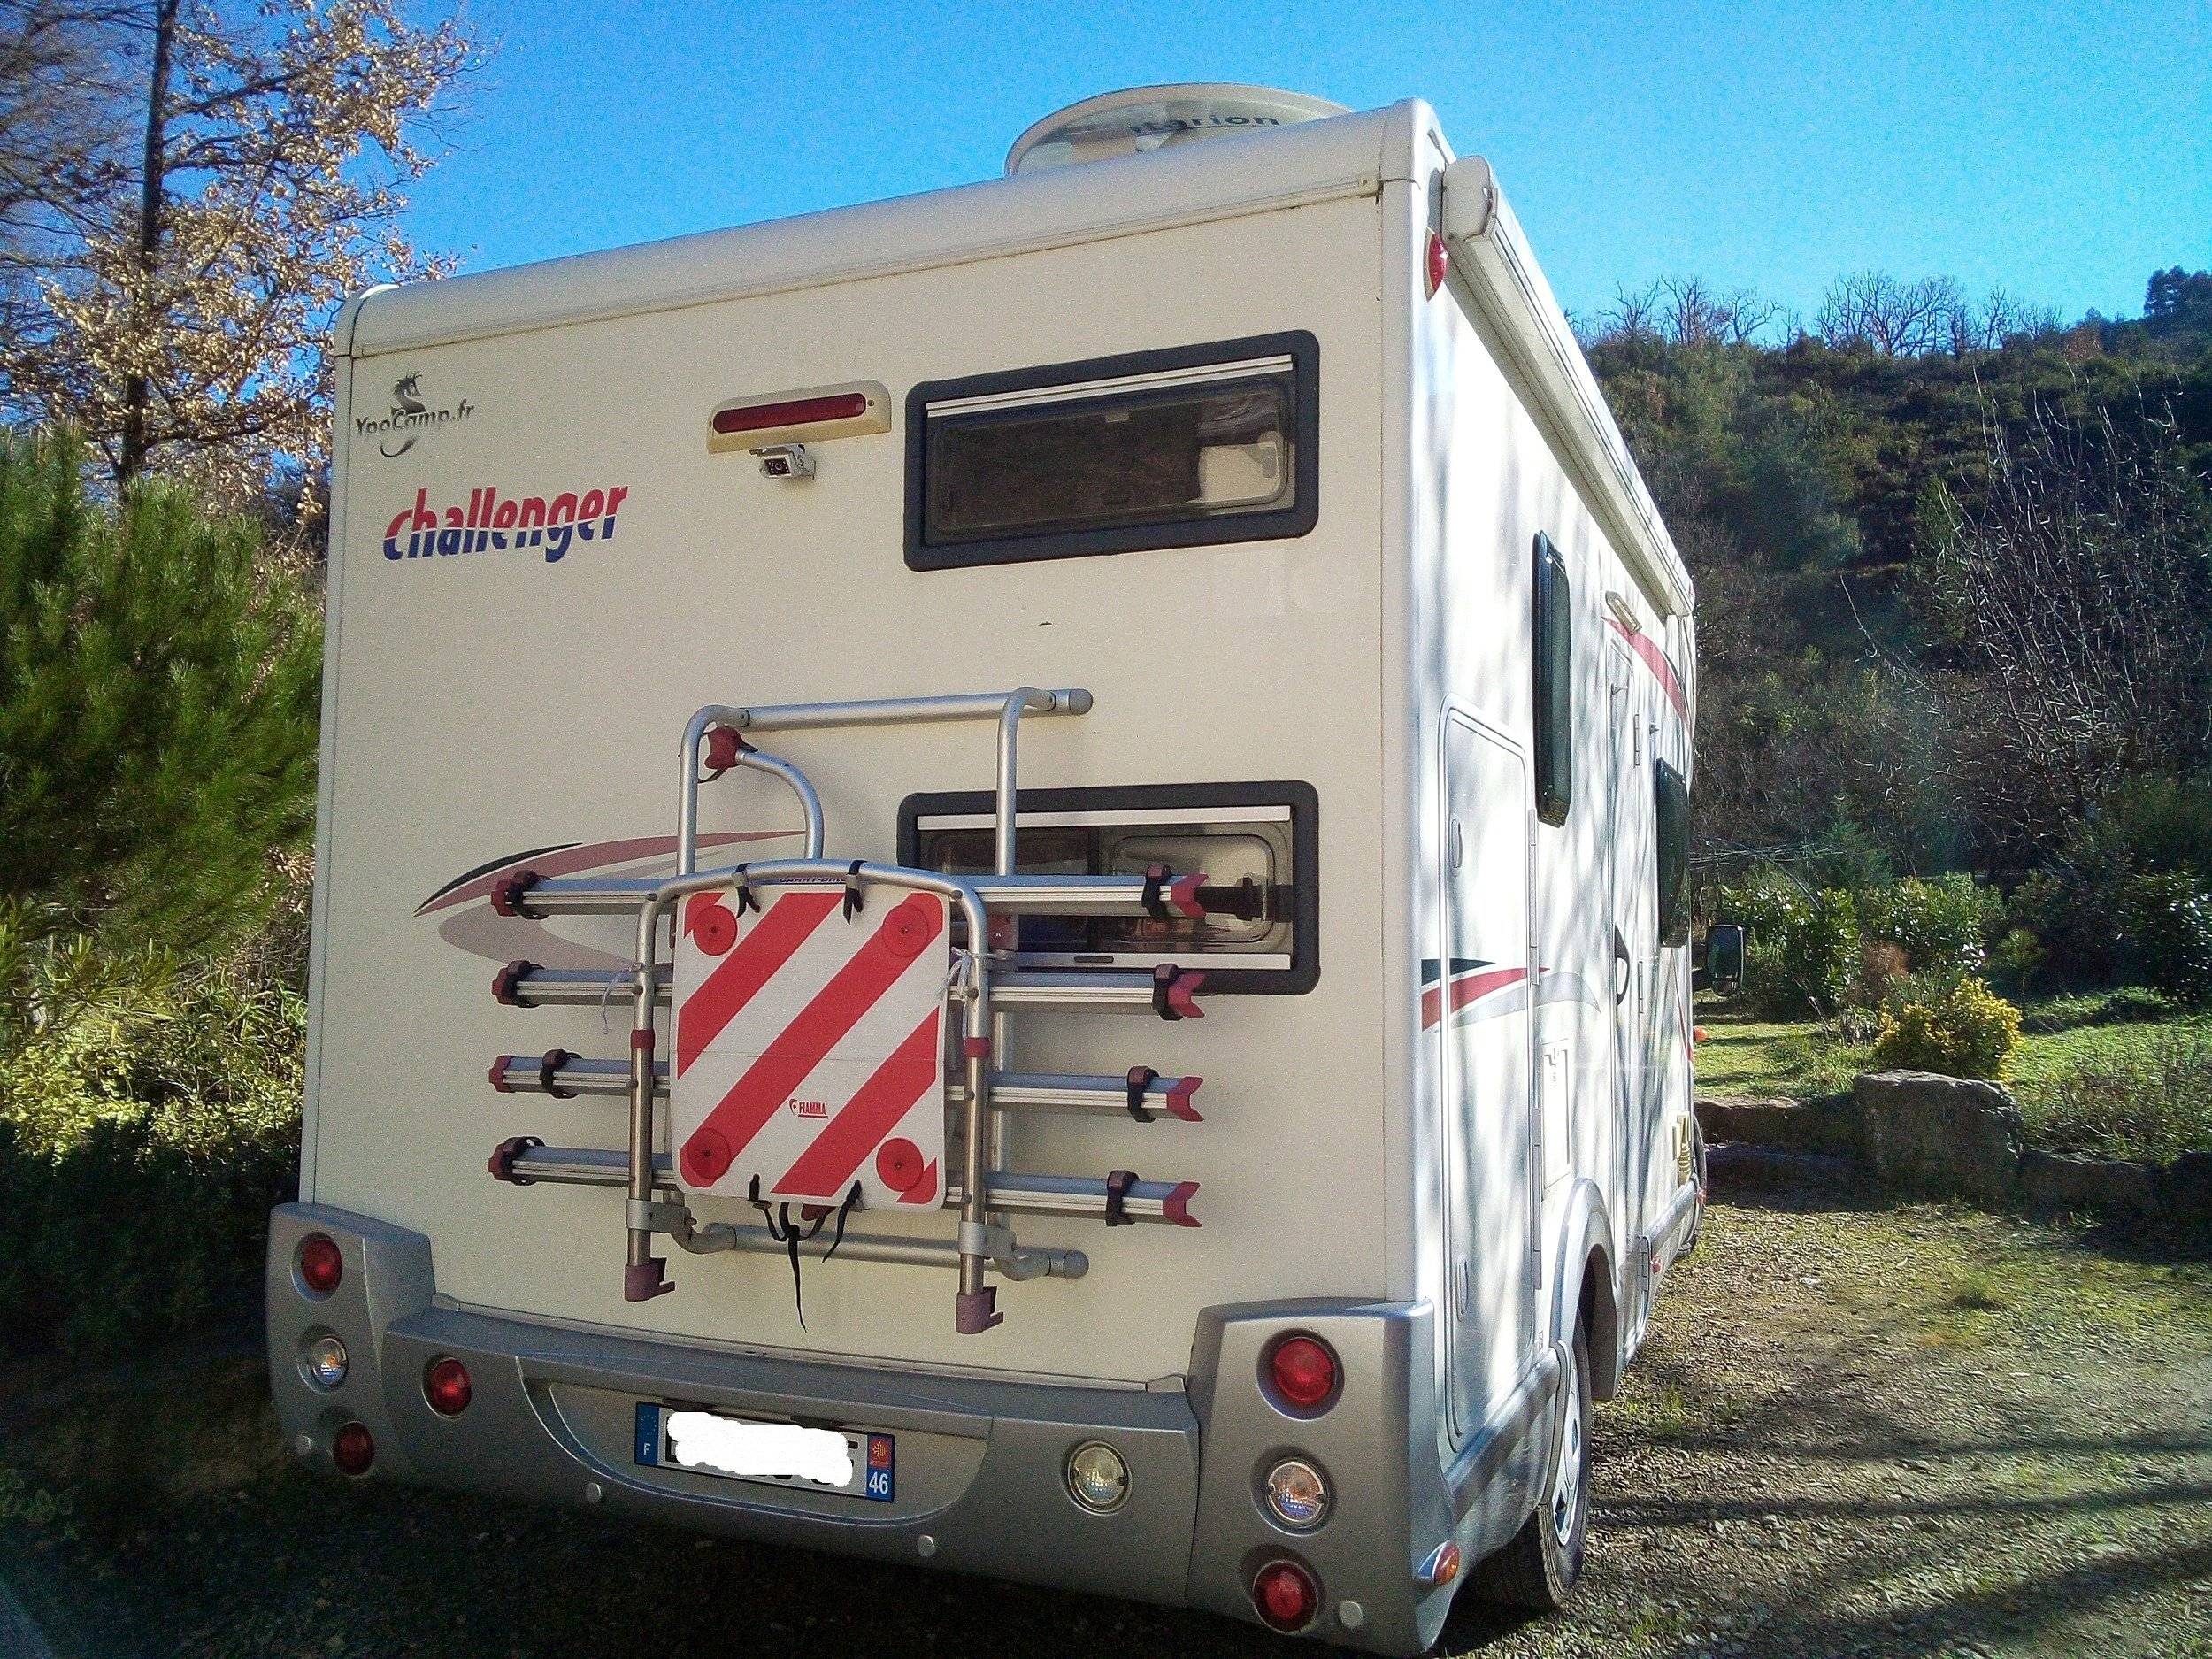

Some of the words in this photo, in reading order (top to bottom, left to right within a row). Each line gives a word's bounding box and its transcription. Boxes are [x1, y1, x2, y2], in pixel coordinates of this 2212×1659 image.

[799, 1101, 826, 1116] FIAMMA
[643, 1442, 651, 1455] F
[868, 1471, 888, 1495] 46
